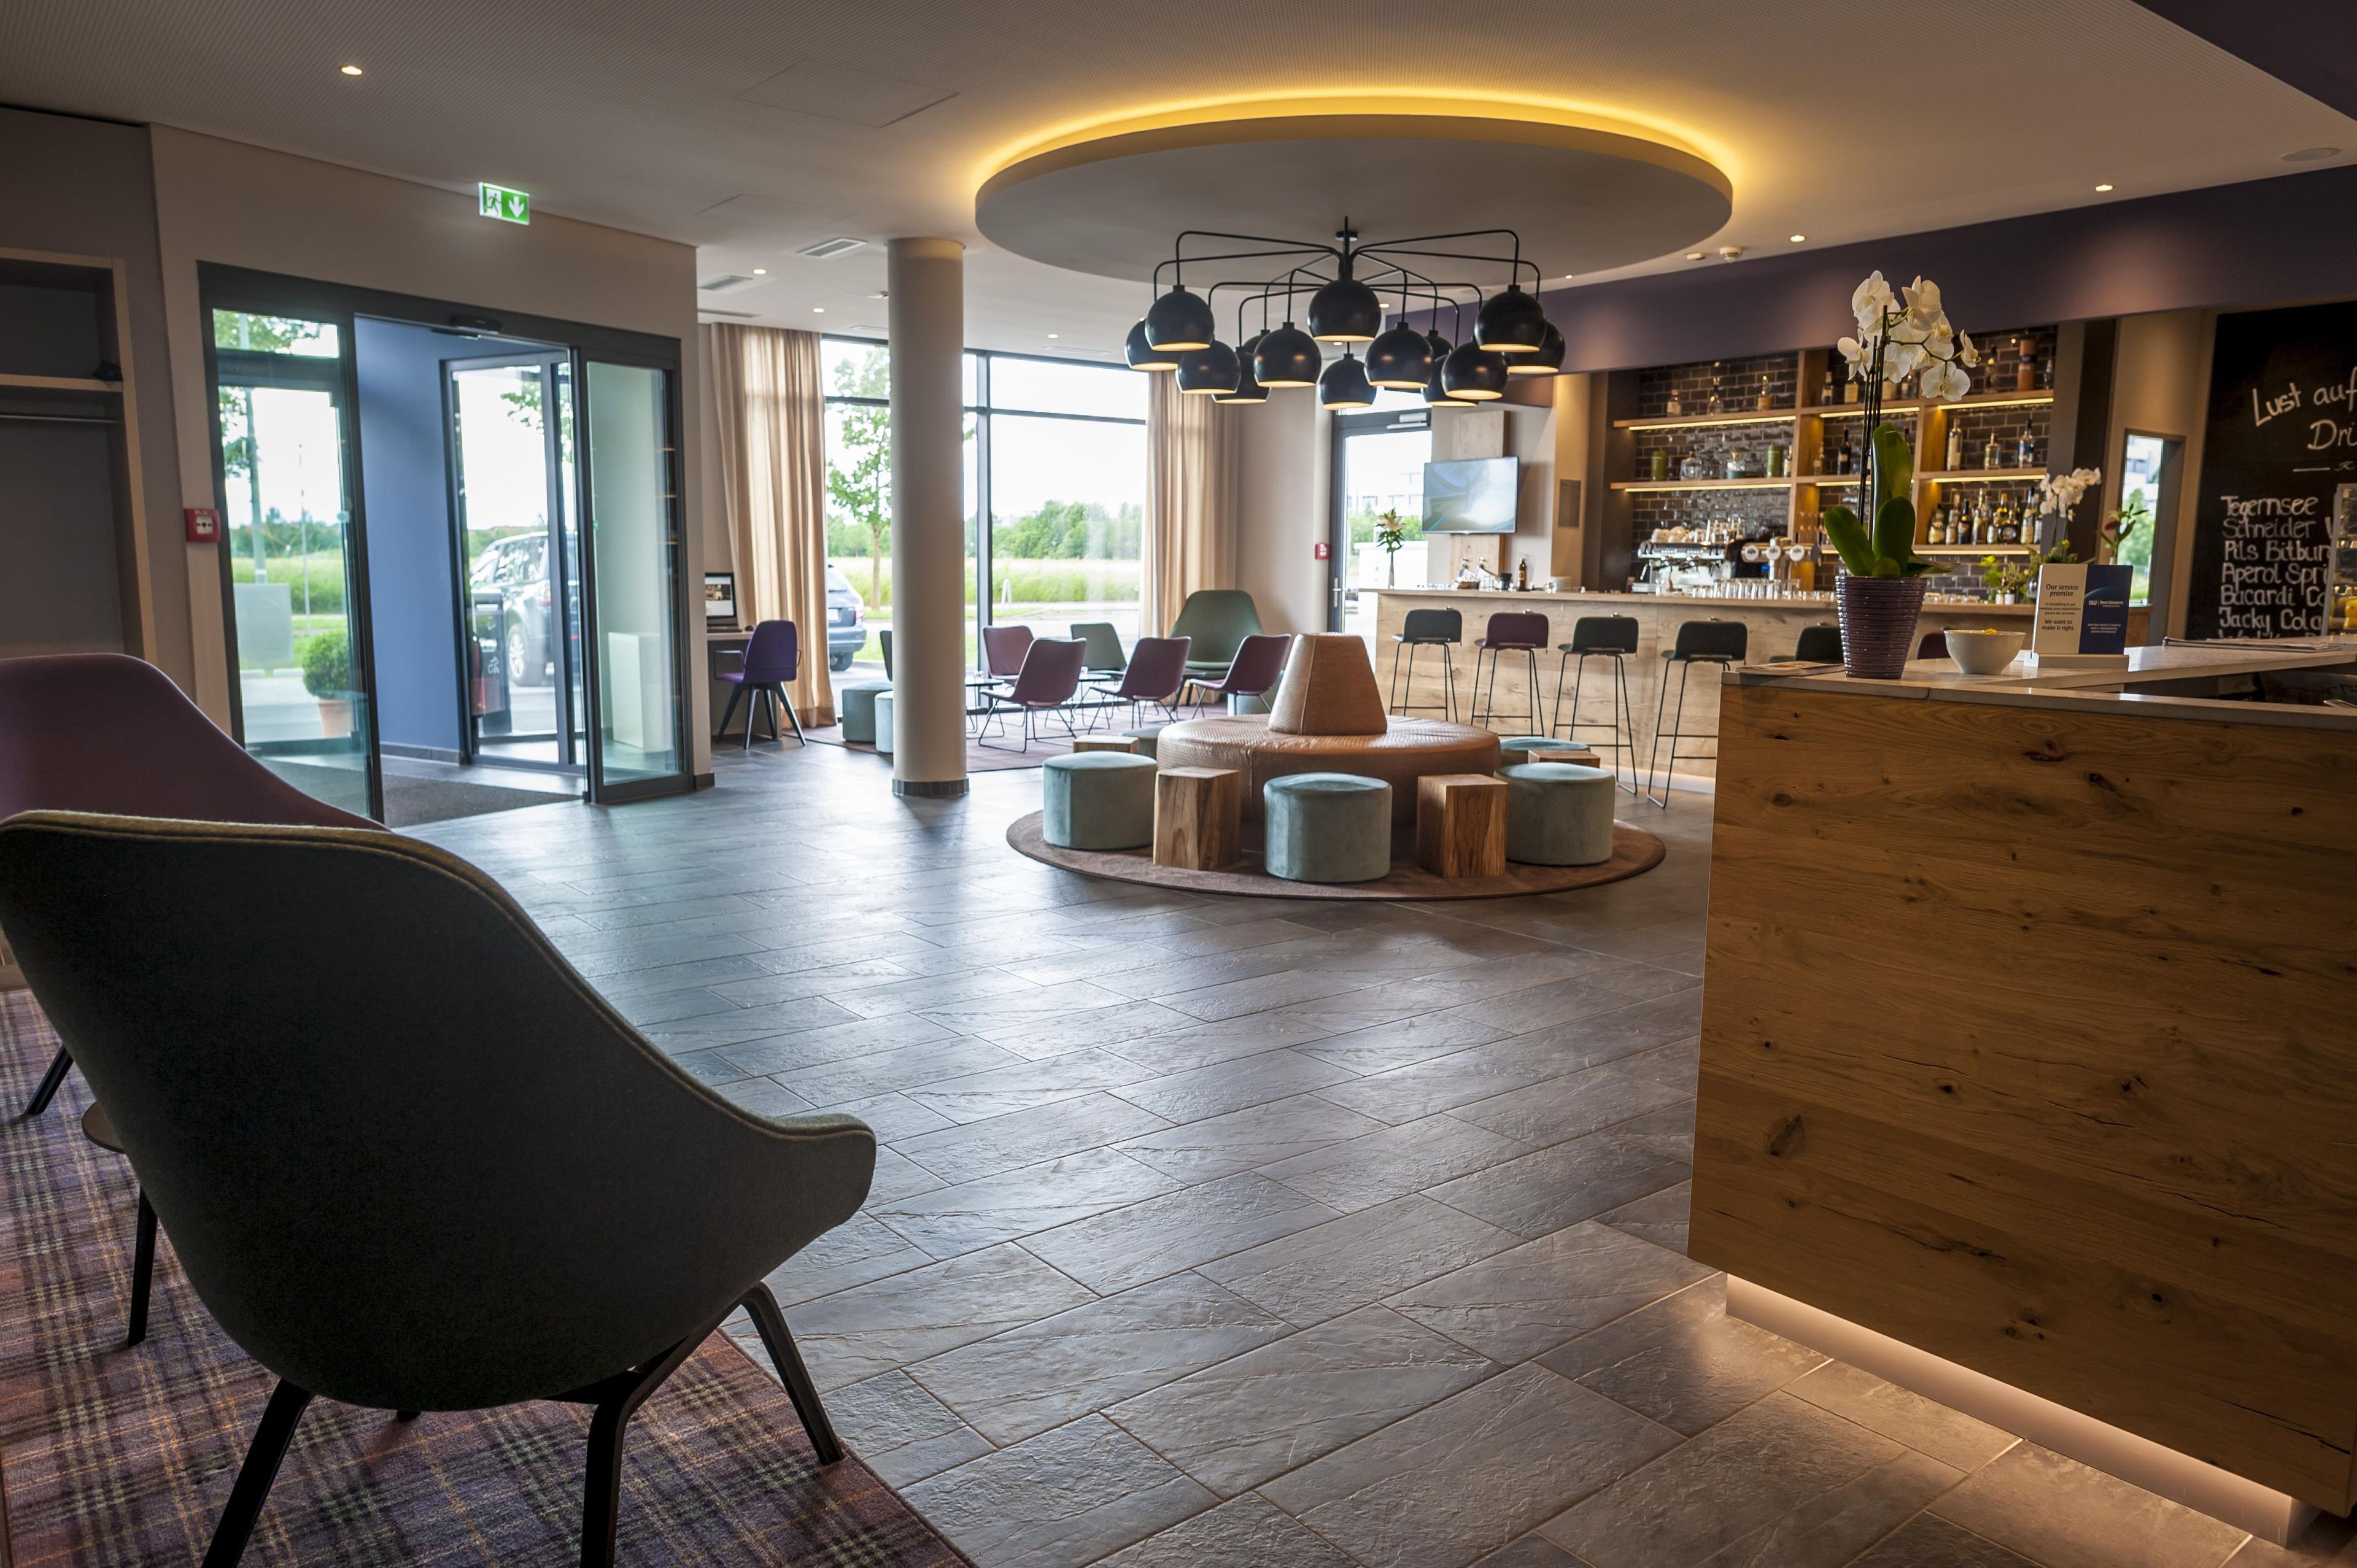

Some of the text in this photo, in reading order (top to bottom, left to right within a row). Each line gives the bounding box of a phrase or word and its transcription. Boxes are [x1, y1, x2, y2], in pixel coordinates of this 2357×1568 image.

[2253, 366, 2357, 427] Lust auf
[2221, 496, 2318, 524] Tegernsee
[2222, 517, 2316, 539] Schneider
[2224, 540, 2331, 562] Pils Bitbur
[2222, 562, 2282, 592] Aperol
[2221, 584, 2296, 605] Bacardi
[2219, 607, 2270, 637] Jacky
[2281, 609, 2322, 630] Cola
